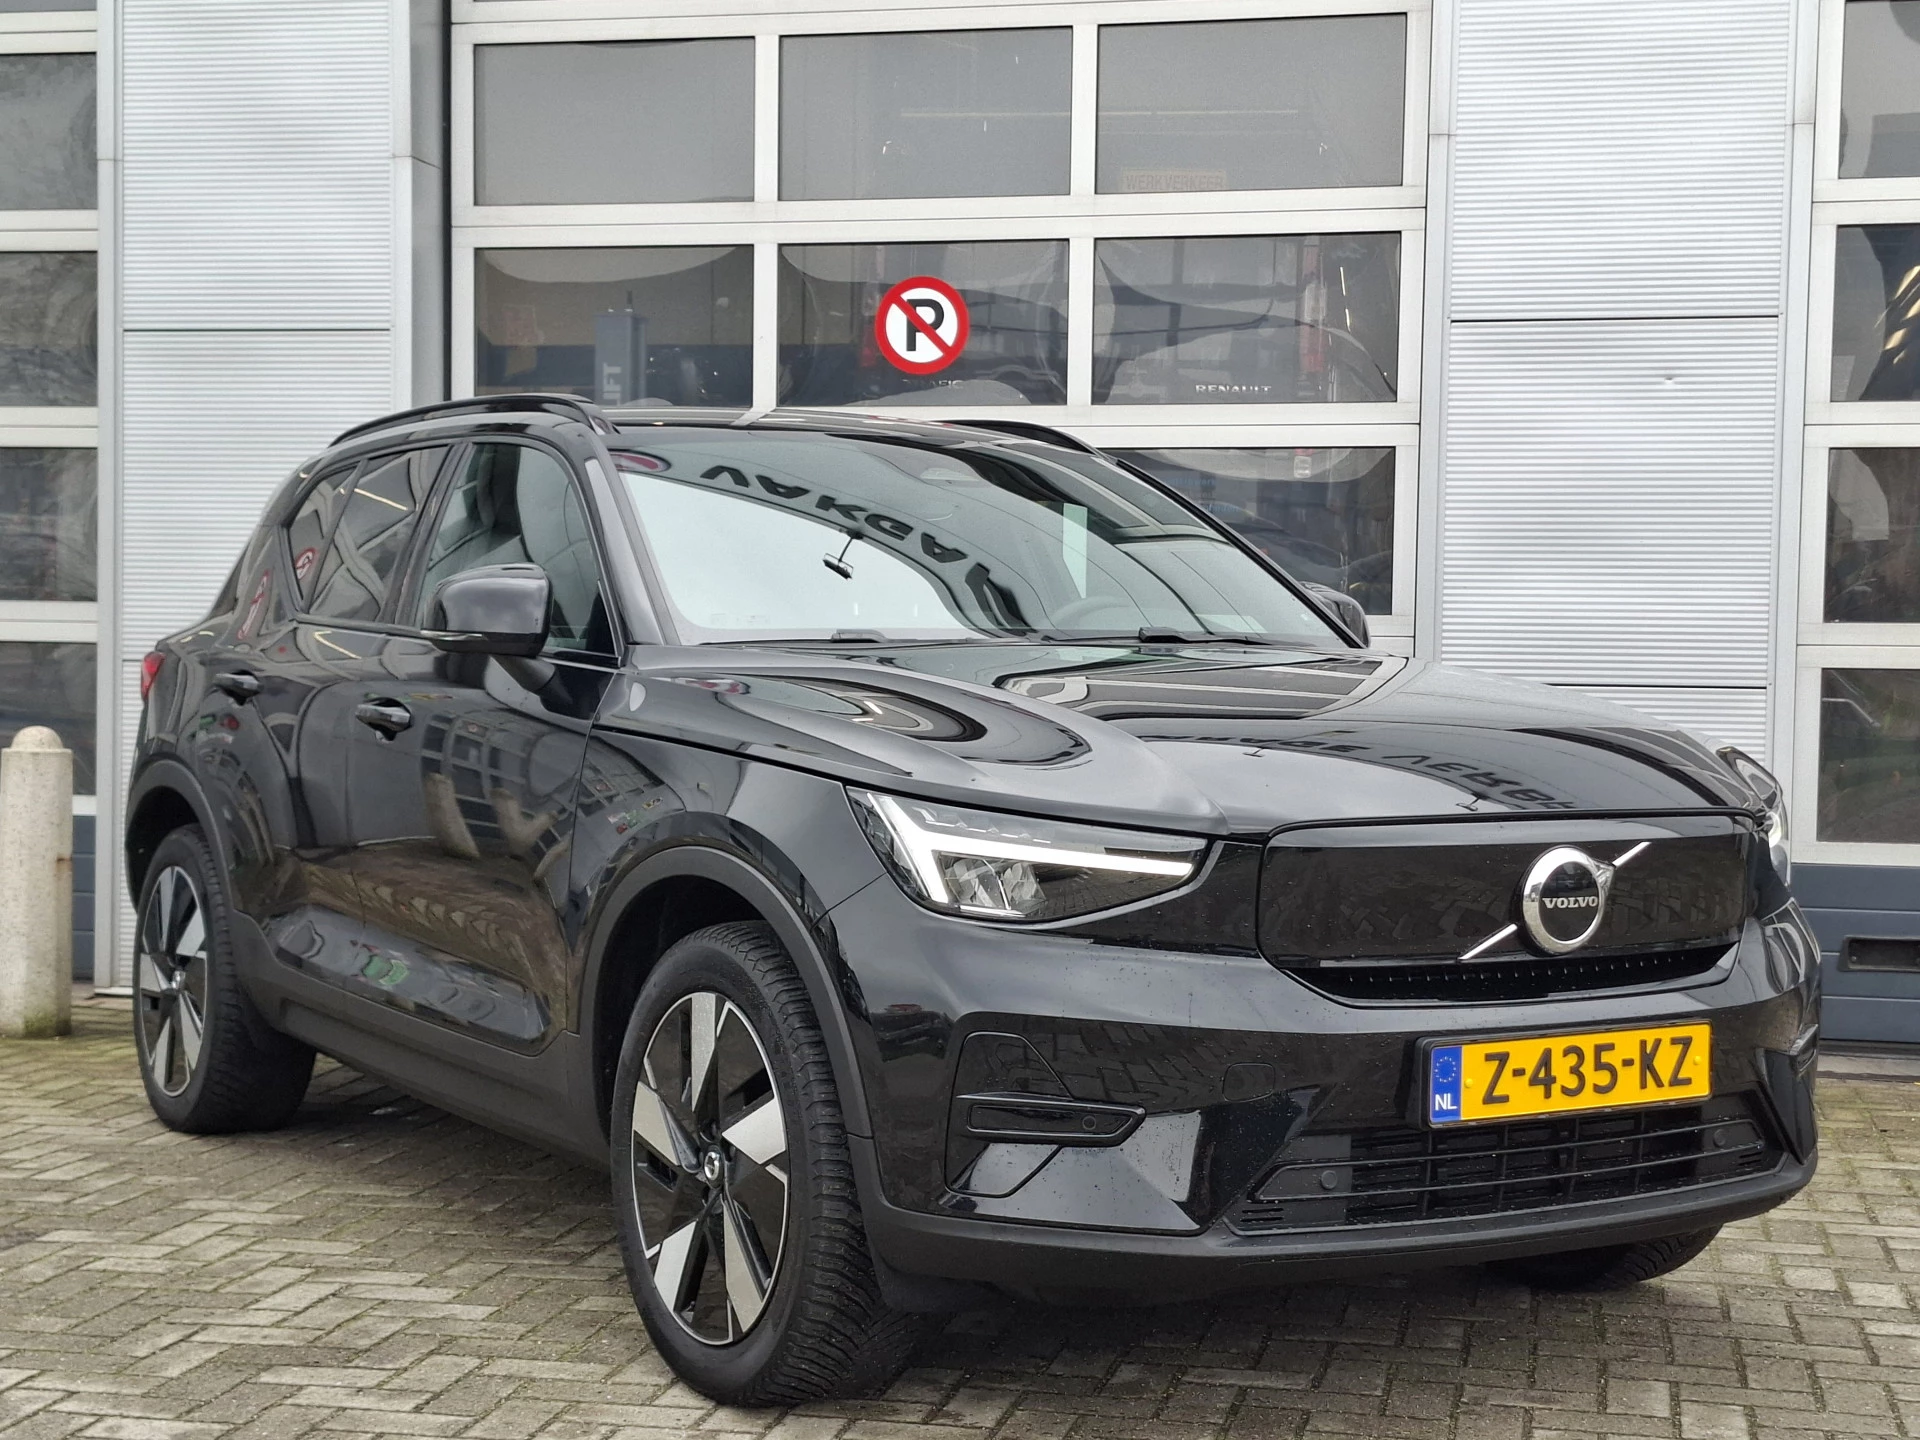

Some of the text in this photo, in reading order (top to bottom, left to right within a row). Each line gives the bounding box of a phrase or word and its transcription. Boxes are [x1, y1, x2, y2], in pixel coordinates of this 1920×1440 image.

[906, 298, 945, 352] P
[1195, 384, 1272, 394] RENAULT
[1542, 896, 1598, 909] VOLVO
[1482, 1036, 1693, 1105] Z-435-KZ
[1435, 1093, 1457, 1111] NL
